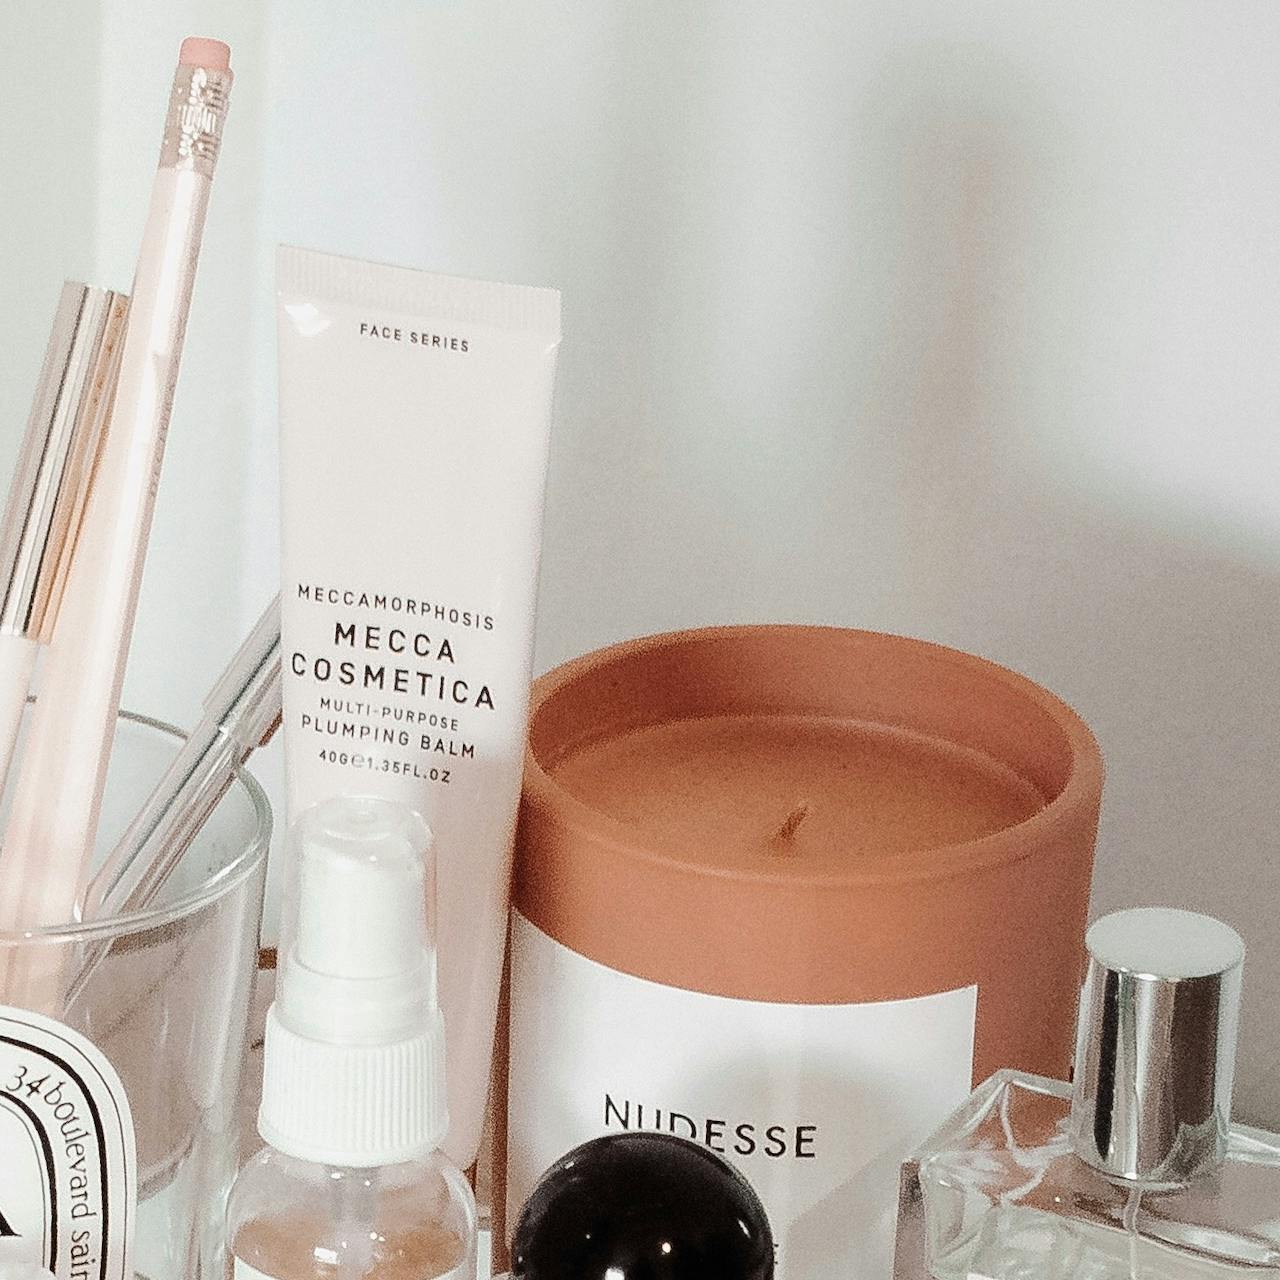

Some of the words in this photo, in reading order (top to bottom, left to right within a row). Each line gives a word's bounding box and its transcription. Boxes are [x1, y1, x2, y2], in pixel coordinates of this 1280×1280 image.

[359, 323, 403, 341] FACE
[410, 332, 470, 352] SERIES
[298, 584, 495, 631] MECCAMORPHOSIS
[334, 622, 456, 664] MECCA
[292, 653, 495, 710] COSMETICA
[302, 714, 410, 746] PLUMPING
[420, 735, 475, 759] BALM
[320, 698, 460, 732] MULTI-PURPOSE
[603, 1093, 818, 1159] NUDESSE
